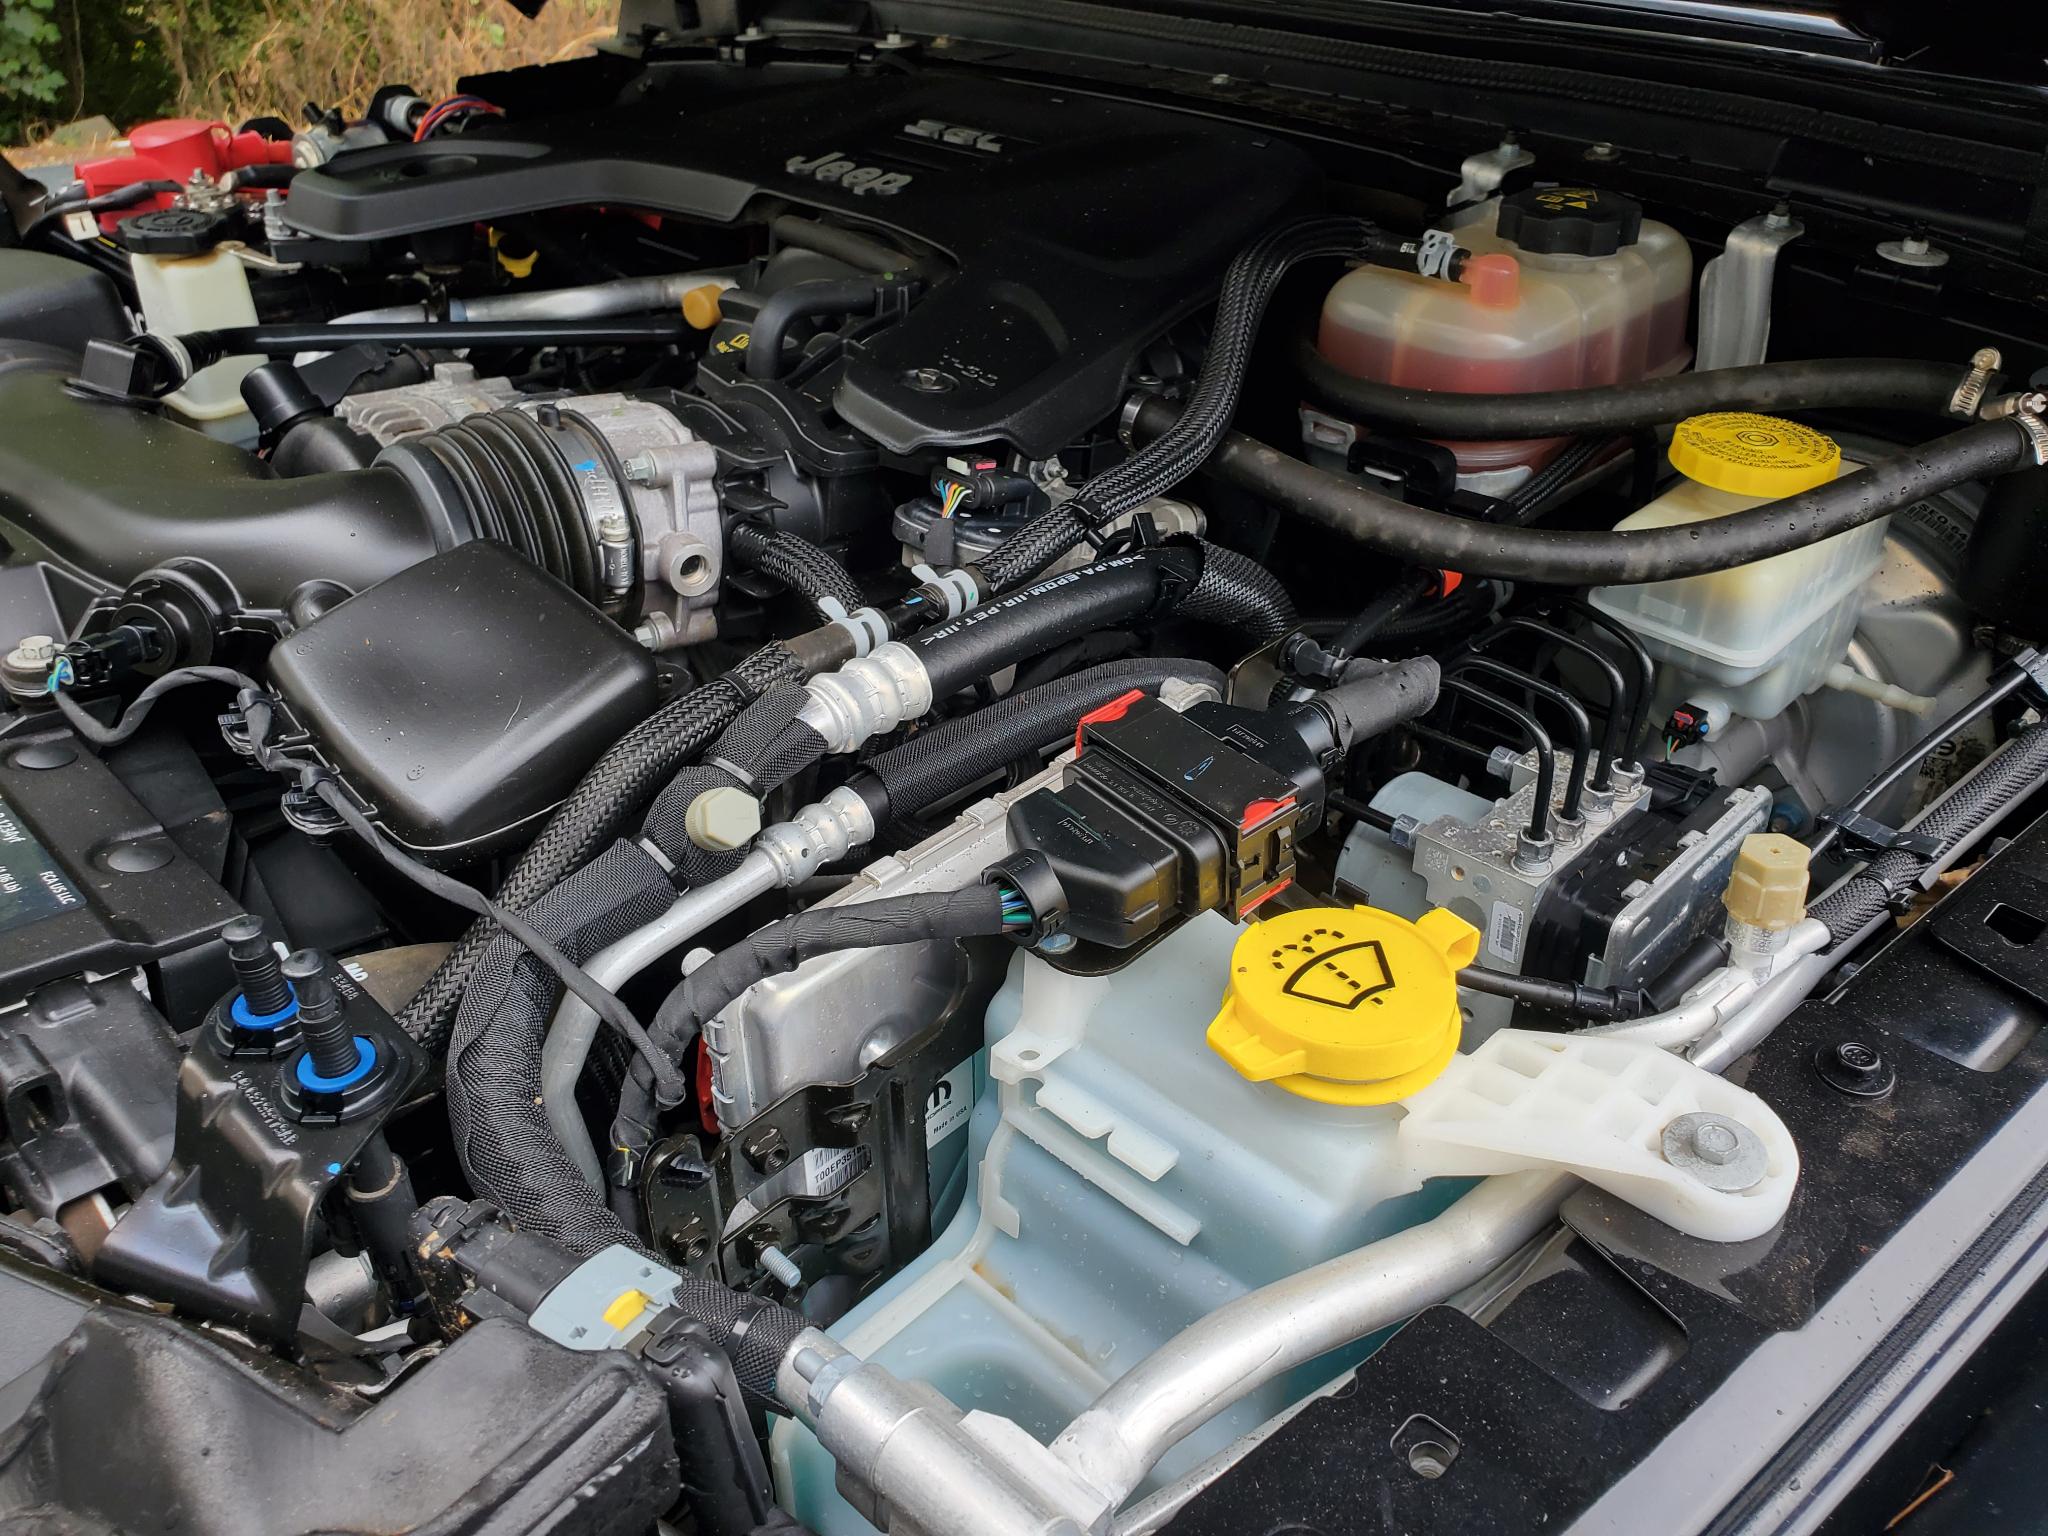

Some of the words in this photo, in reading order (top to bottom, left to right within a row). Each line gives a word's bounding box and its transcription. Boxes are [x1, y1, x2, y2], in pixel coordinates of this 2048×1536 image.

[786, 151, 913, 196] Jeep
[40, 870, 60, 885] FCA
[49, 882, 67, 894] US
[56, 891, 76, 905] LLC
[933, 1120, 948, 1134] Made
